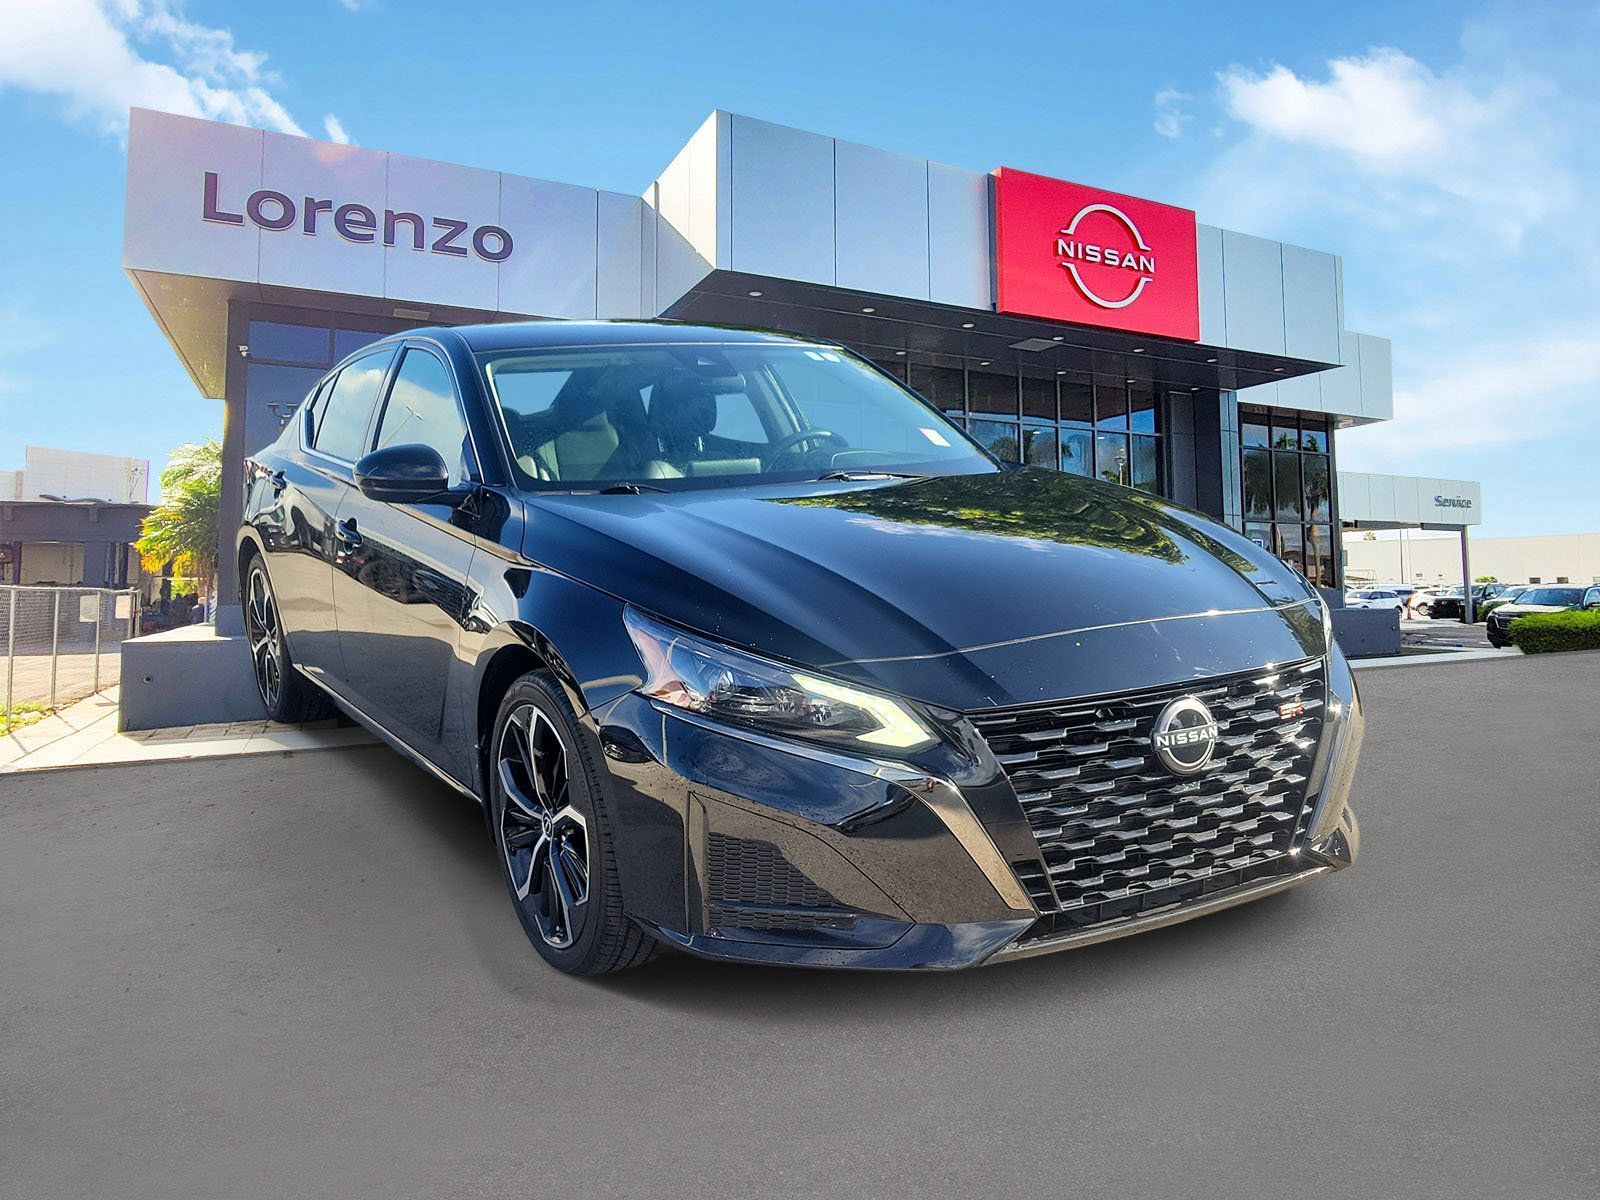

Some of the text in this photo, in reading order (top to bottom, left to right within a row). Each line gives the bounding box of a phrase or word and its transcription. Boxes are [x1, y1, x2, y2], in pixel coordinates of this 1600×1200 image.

[203, 171, 514, 261] Lorenzo
[1057, 238, 1155, 273] NISSAN
[1434, 495, 1472, 508] Service
[1156, 725, 1218, 747] NISSAN
